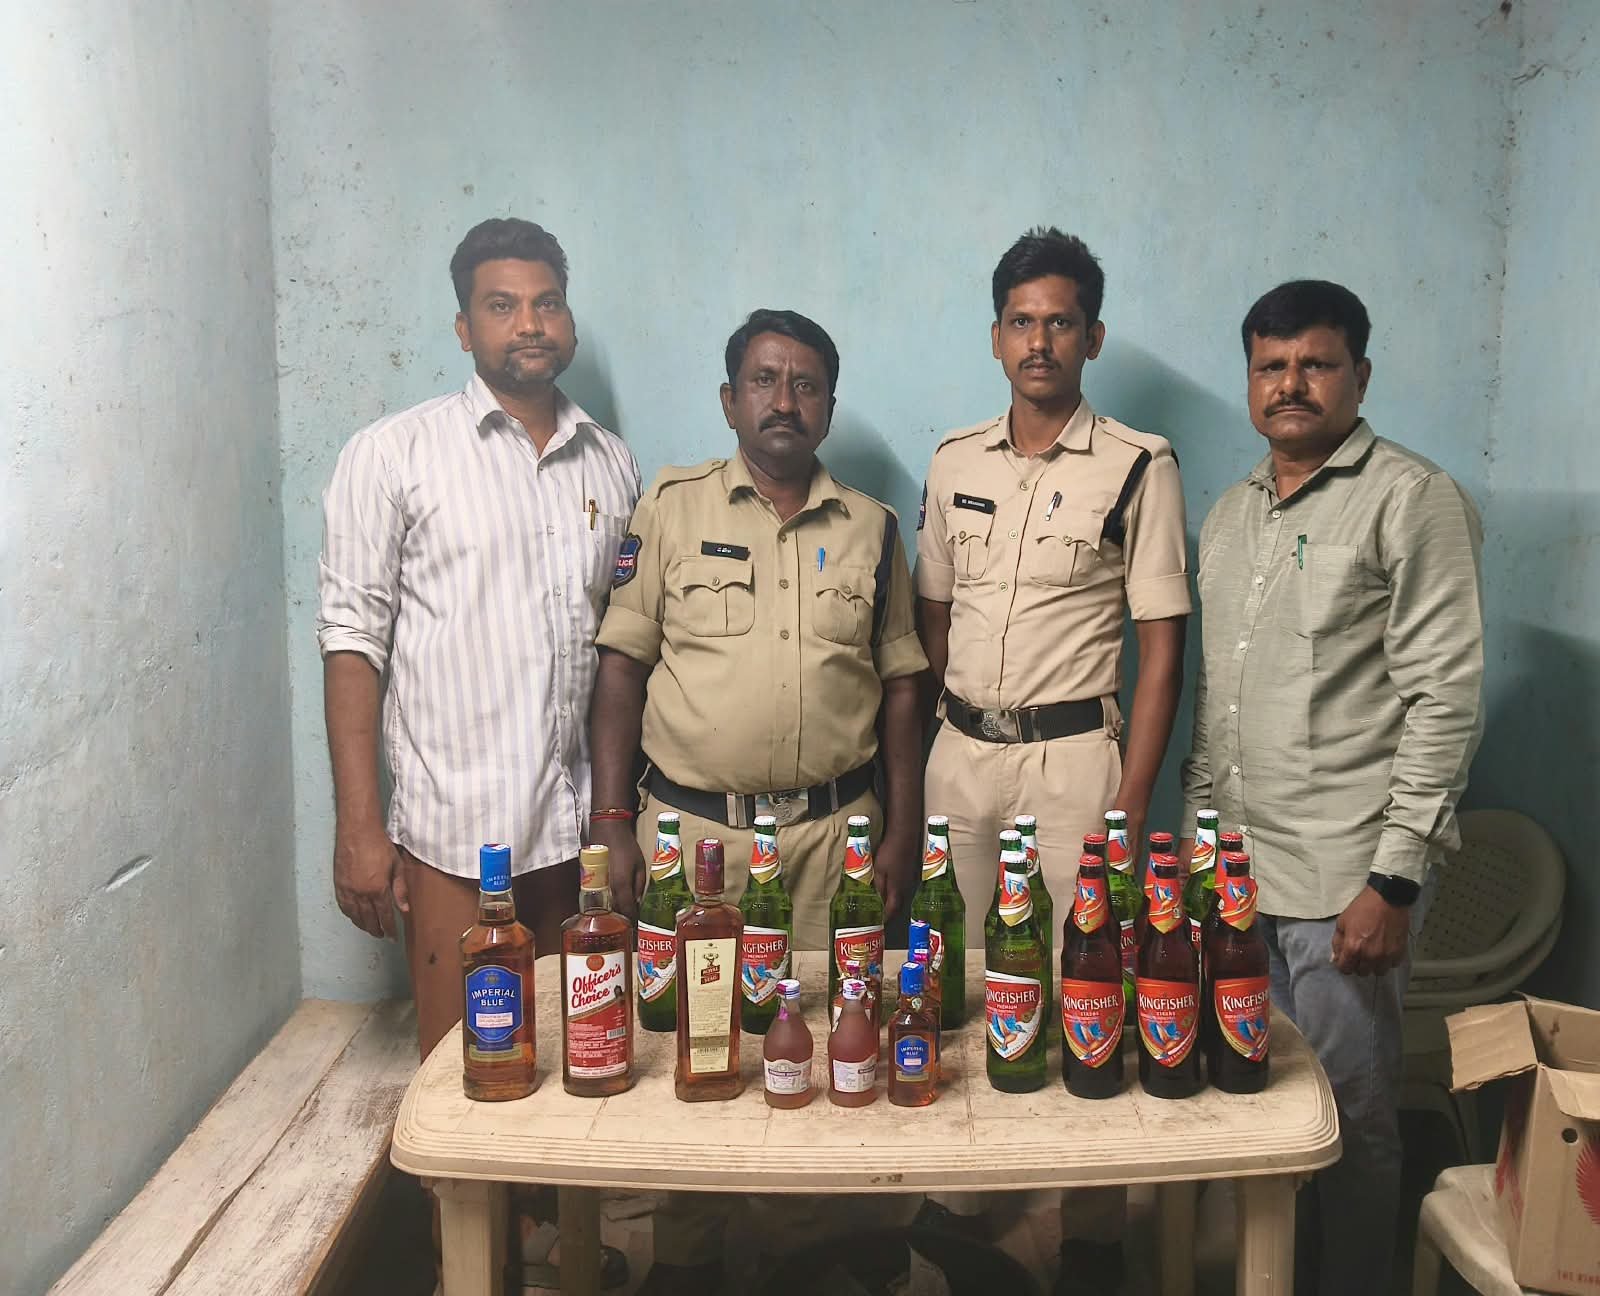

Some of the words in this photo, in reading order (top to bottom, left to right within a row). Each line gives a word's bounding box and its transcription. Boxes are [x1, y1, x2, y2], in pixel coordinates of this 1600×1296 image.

[617, 559, 634, 567] LICE
[742, 939, 784, 955] NGFISHER
[573, 964, 622, 995] Officer's
[471, 988, 516, 1001] IMPERIAL
[480, 998, 505, 1007] BLUE
[571, 988, 611, 1009] Choice
[1063, 993, 1119, 1011] KINGFISHER
[1139, 992, 1195, 1011] KINGFISHER
[1222, 989, 1269, 1012] KINGFISH
